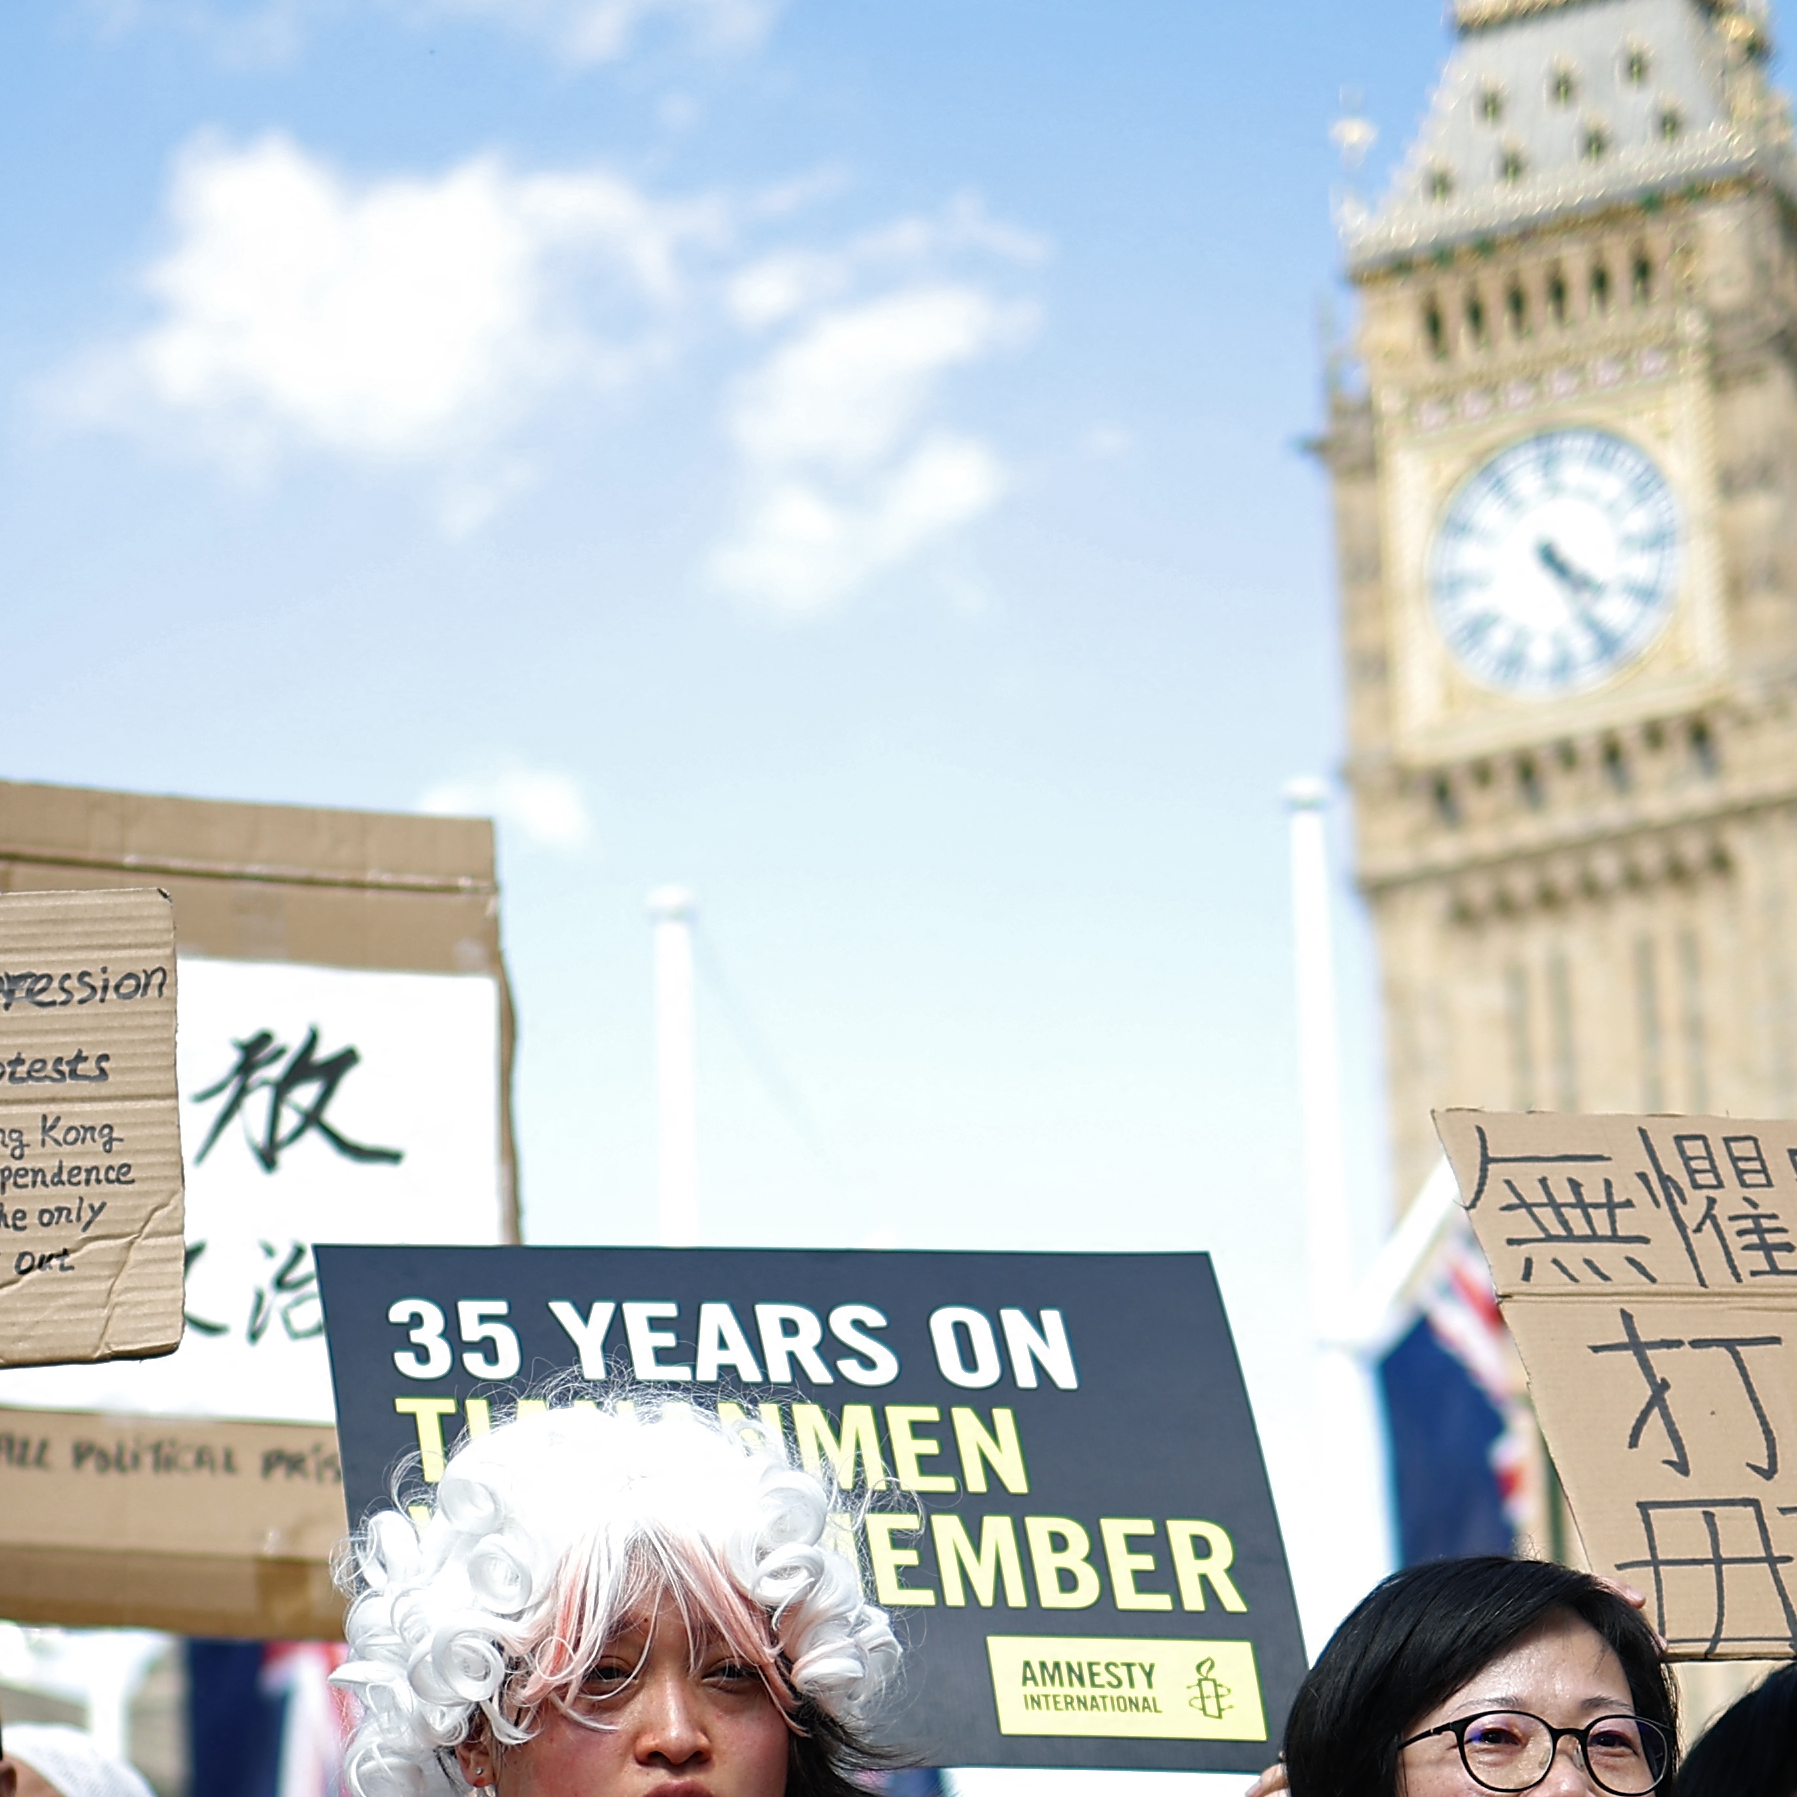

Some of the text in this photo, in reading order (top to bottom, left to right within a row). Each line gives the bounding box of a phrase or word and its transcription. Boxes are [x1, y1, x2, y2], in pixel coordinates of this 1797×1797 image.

[40, 1114, 124, 1153] Kong
[38, 1196, 107, 1232] only
[388, 1297, 1079, 1391] 35 YEARS ON
[1021, 1660, 1155, 1690] AMNESTY
[1023, 1694, 1163, 1713] INTERNATIONAL
